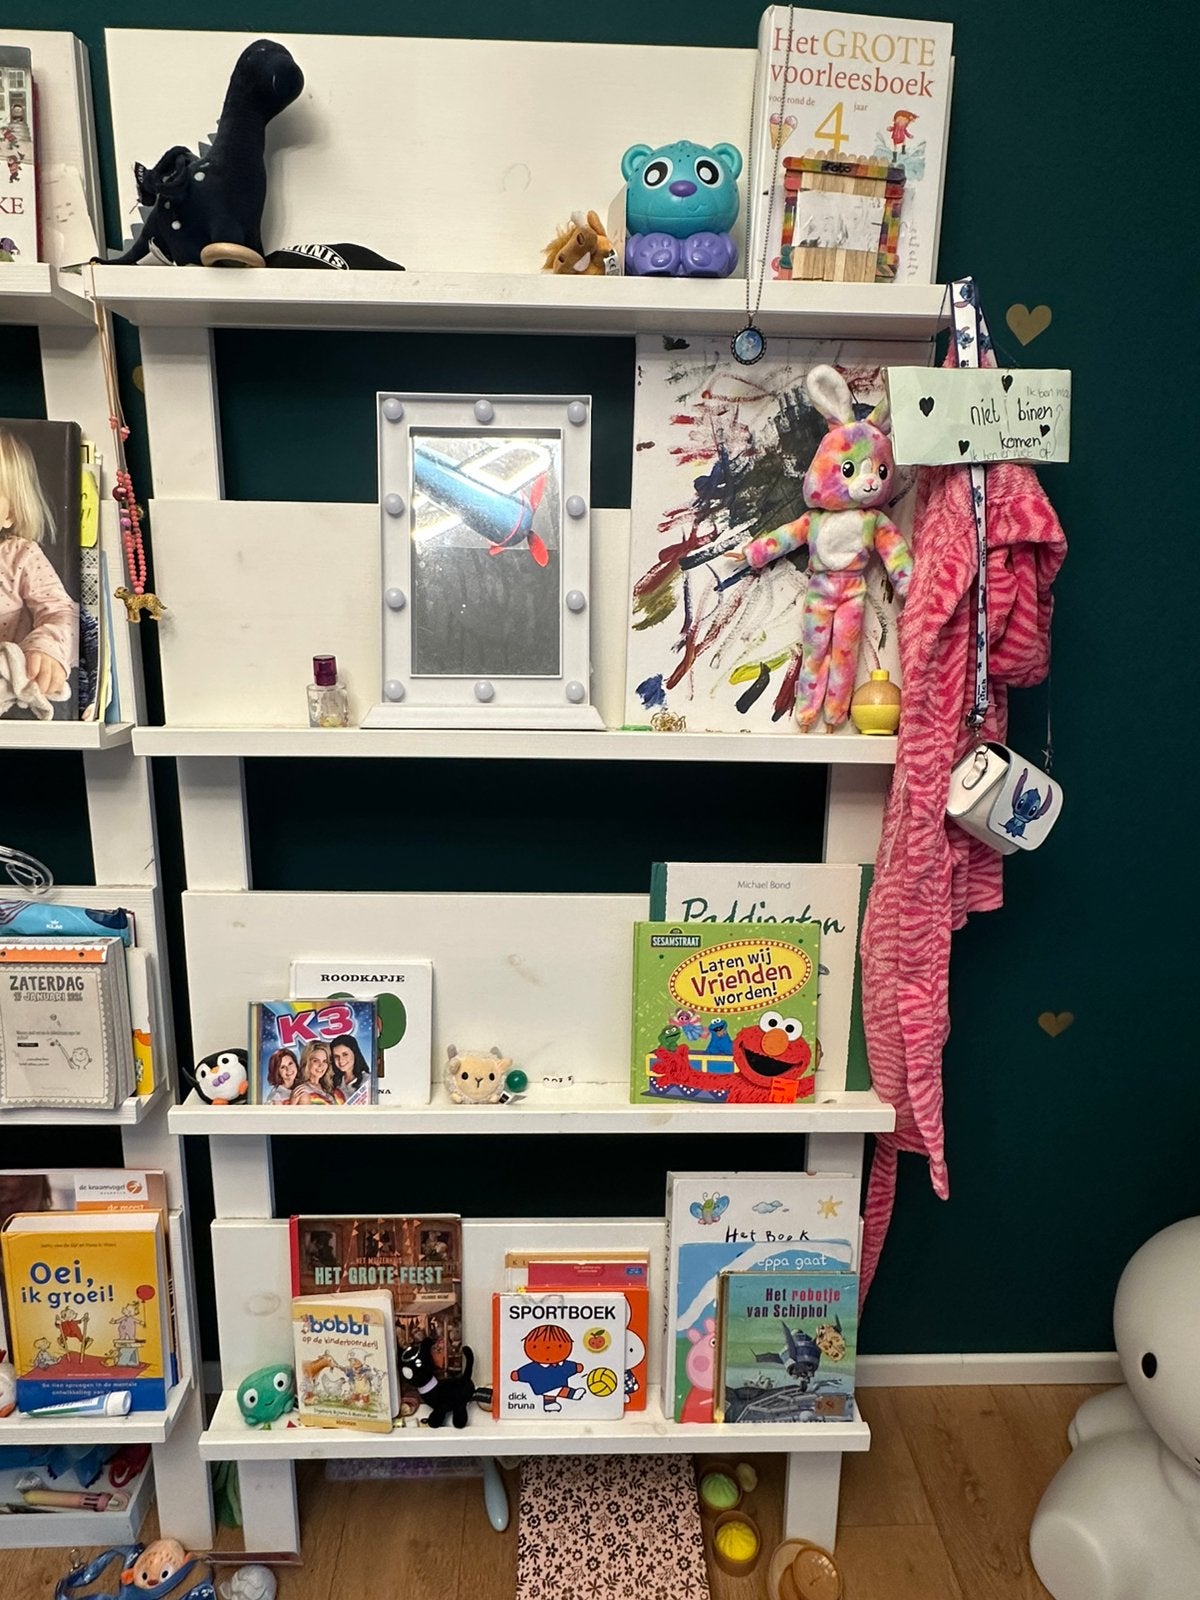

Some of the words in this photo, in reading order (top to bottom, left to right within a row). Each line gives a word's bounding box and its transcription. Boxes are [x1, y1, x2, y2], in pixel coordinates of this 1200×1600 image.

[773, 27, 819, 56] Het
[822, 28, 936, 67] GROTE
[771, 62, 934, 98] voorleesboek
[786, 96, 805, 106] rond
[806, 97, 816, 106] de
[853, 102, 869, 112] jaar
[814, 102, 849, 155] 4
[970, 398, 1001, 426] niet
[1017, 397, 1053, 421] binen
[999, 431, 1042, 450] komen
[737, 880, 768, 890] Michael
[770, 881, 791, 890] Bond
[652, 936, 700, 946] SESAMSTRAAT
[698, 956, 745, 975] Laten
[747, 947, 772, 966] wij
[9, 975, 85, 991] ZATERDAG
[320, 974, 405, 983] ROODKAPJE
[690, 962, 793, 997] Vrienden
[713, 981, 778, 1007] worden!
[276, 1003, 355, 1046] K3
[725, 1225, 756, 1243] Het
[757, 1257, 789, 1271] eppa
[795, 1254, 827, 1270] gaat
[30, 1259, 94, 1288] Oei,
[315, 1267, 341, 1285] HET
[348, 1267, 395, 1285] GROTE
[400, 1267, 444, 1285] FEEST
[21, 1286, 42, 1303] ik
[47, 1284, 114, 1309] groei!
[765, 1288, 787, 1302] Het
[791, 1287, 841, 1304] robotje
[509, 1306, 616, 1320] SPORTBOEK
[747, 1306, 769, 1318] van
[773, 1304, 828, 1319] Schiphol
[308, 1314, 369, 1336] bobbi
[302, 1336, 312, 1344] op
[313, 1336, 323, 1344] de
[324, 1335, 379, 1350] kinderboerderij
[508, 1392, 527, 1401] dick
[508, 1402, 535, 1410] bruna
